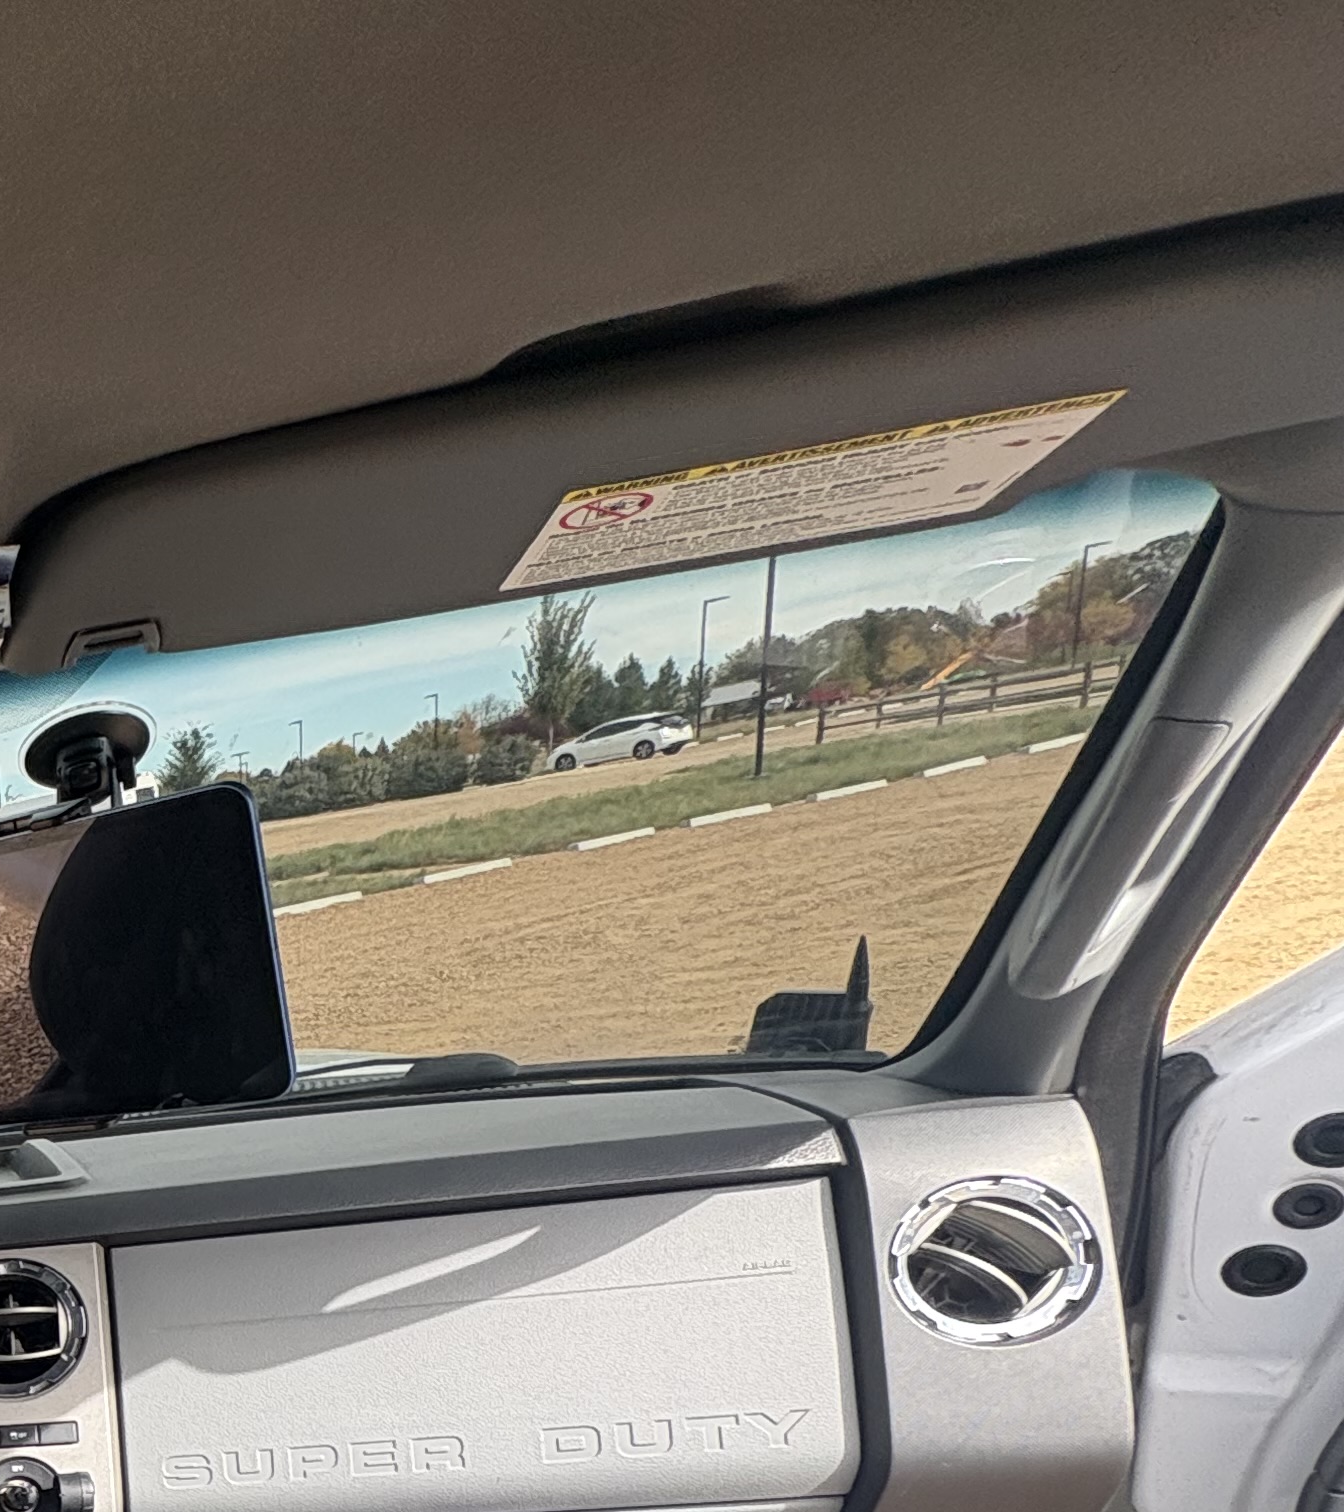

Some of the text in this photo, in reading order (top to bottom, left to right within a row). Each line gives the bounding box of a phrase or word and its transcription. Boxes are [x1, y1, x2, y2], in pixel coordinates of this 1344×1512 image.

[598, 472, 689, 493] WARNING
[732, 430, 914, 470] AVERTISSEMENT
[959, 393, 1116, 427] ADVERTENCIA
[160, 1409, 810, 1491] SUPER DUTY
